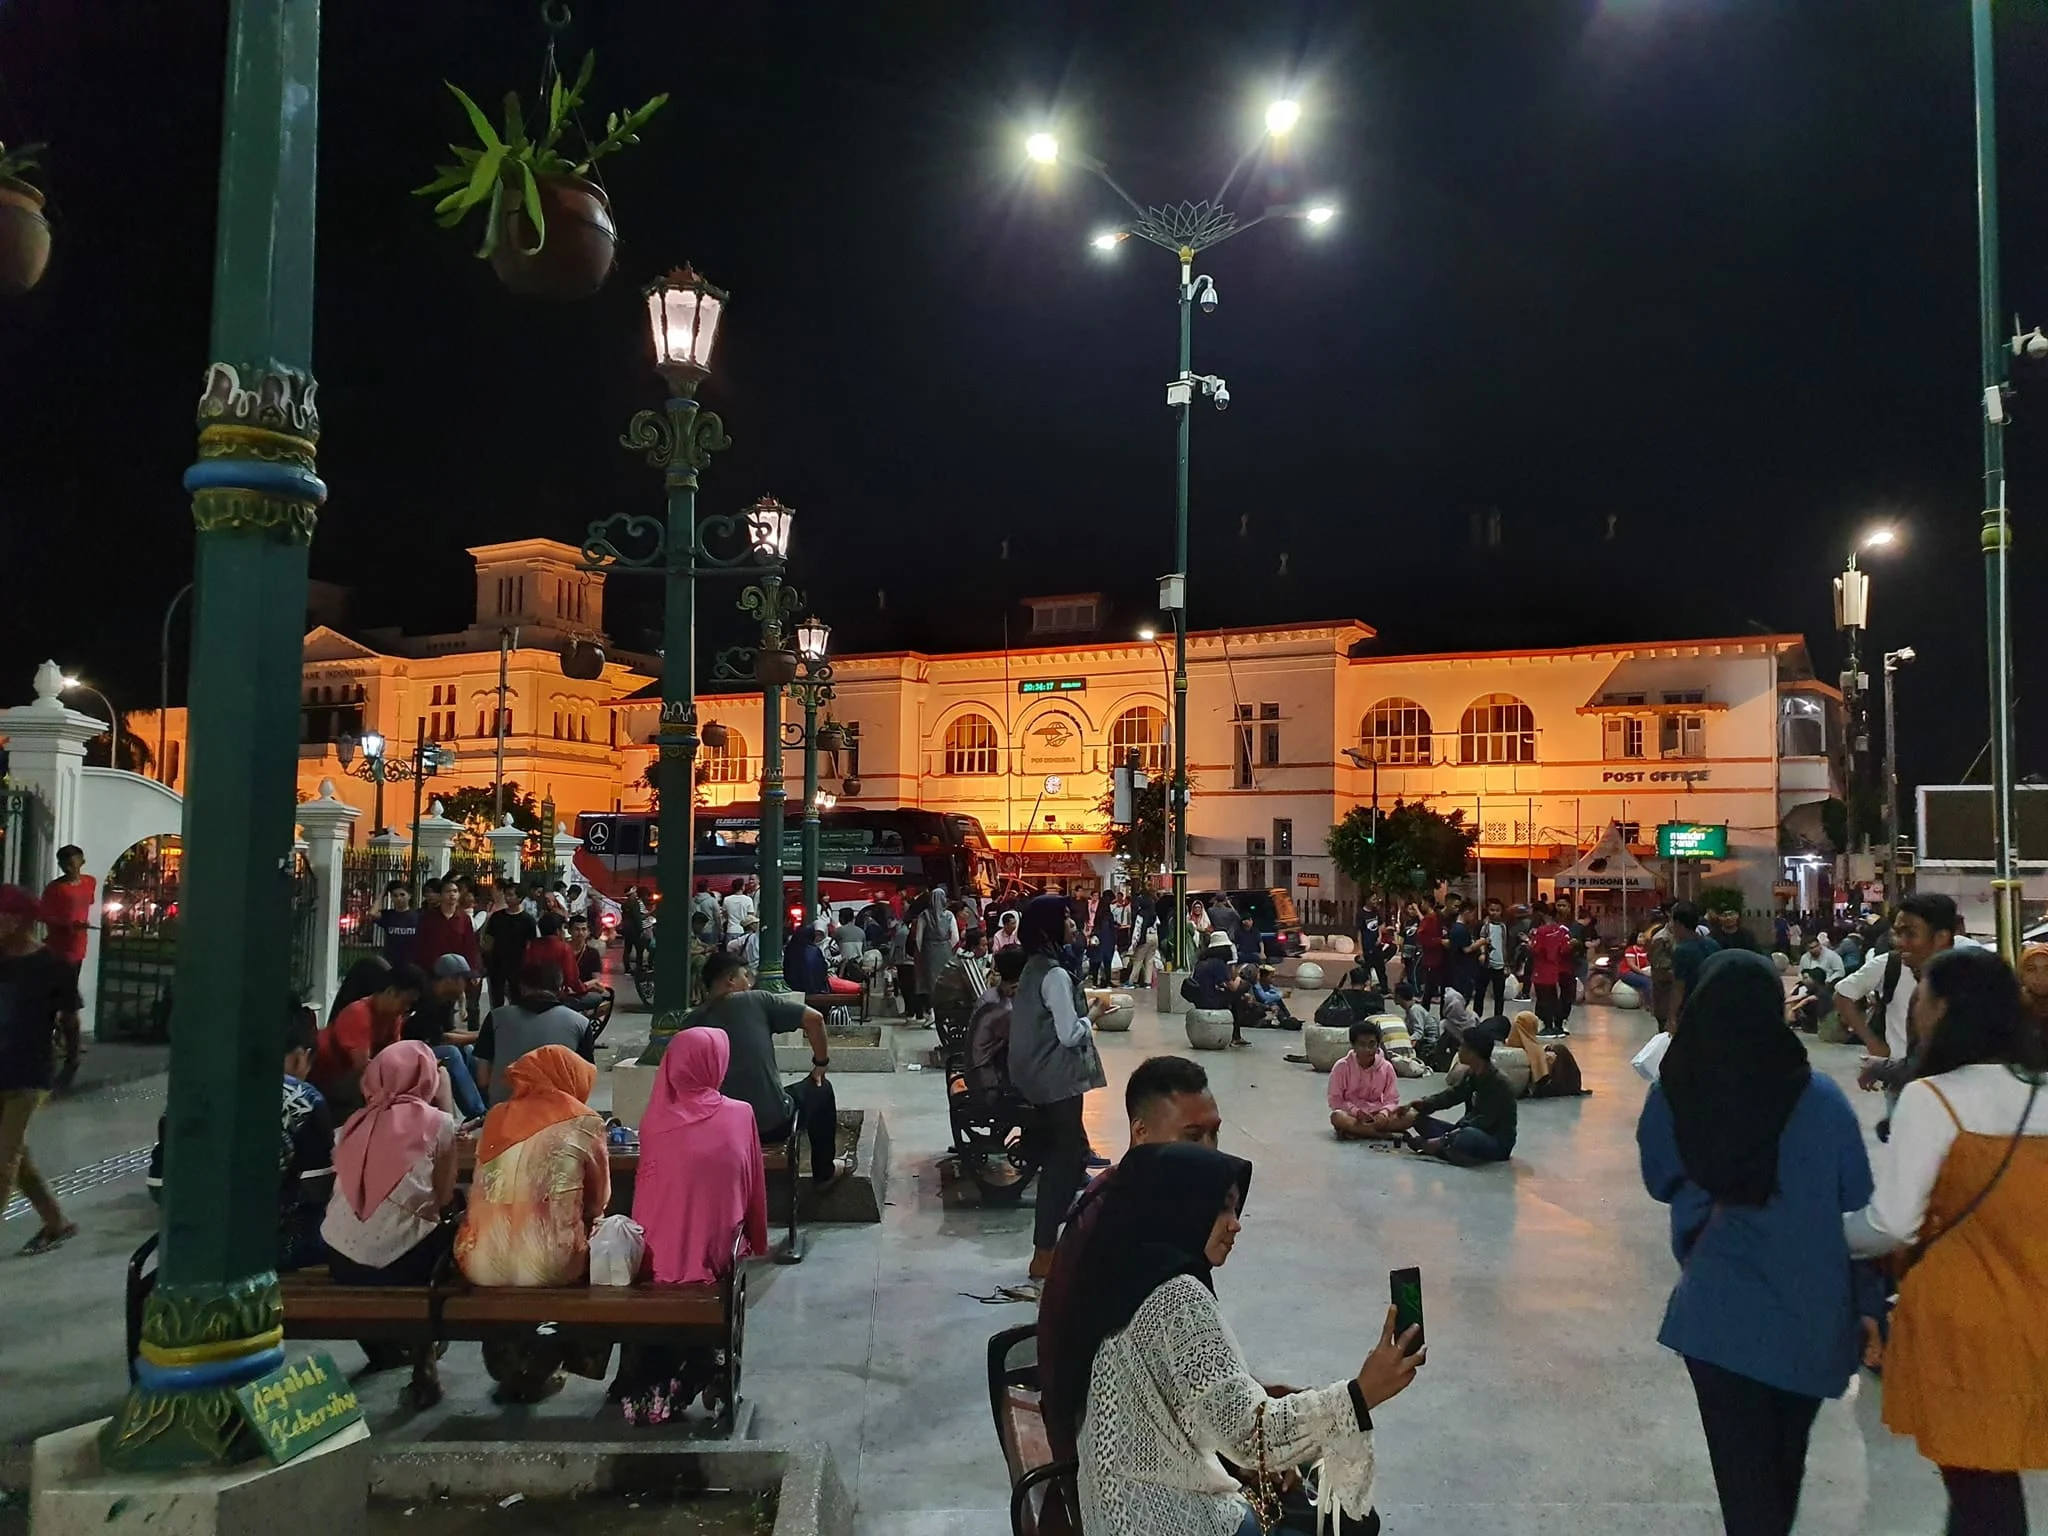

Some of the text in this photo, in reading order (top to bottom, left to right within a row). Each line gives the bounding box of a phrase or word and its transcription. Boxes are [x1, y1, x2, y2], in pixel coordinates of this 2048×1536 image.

[1602, 770, 1712, 783] POST OFFICE
[852, 865, 904, 875] BSM
